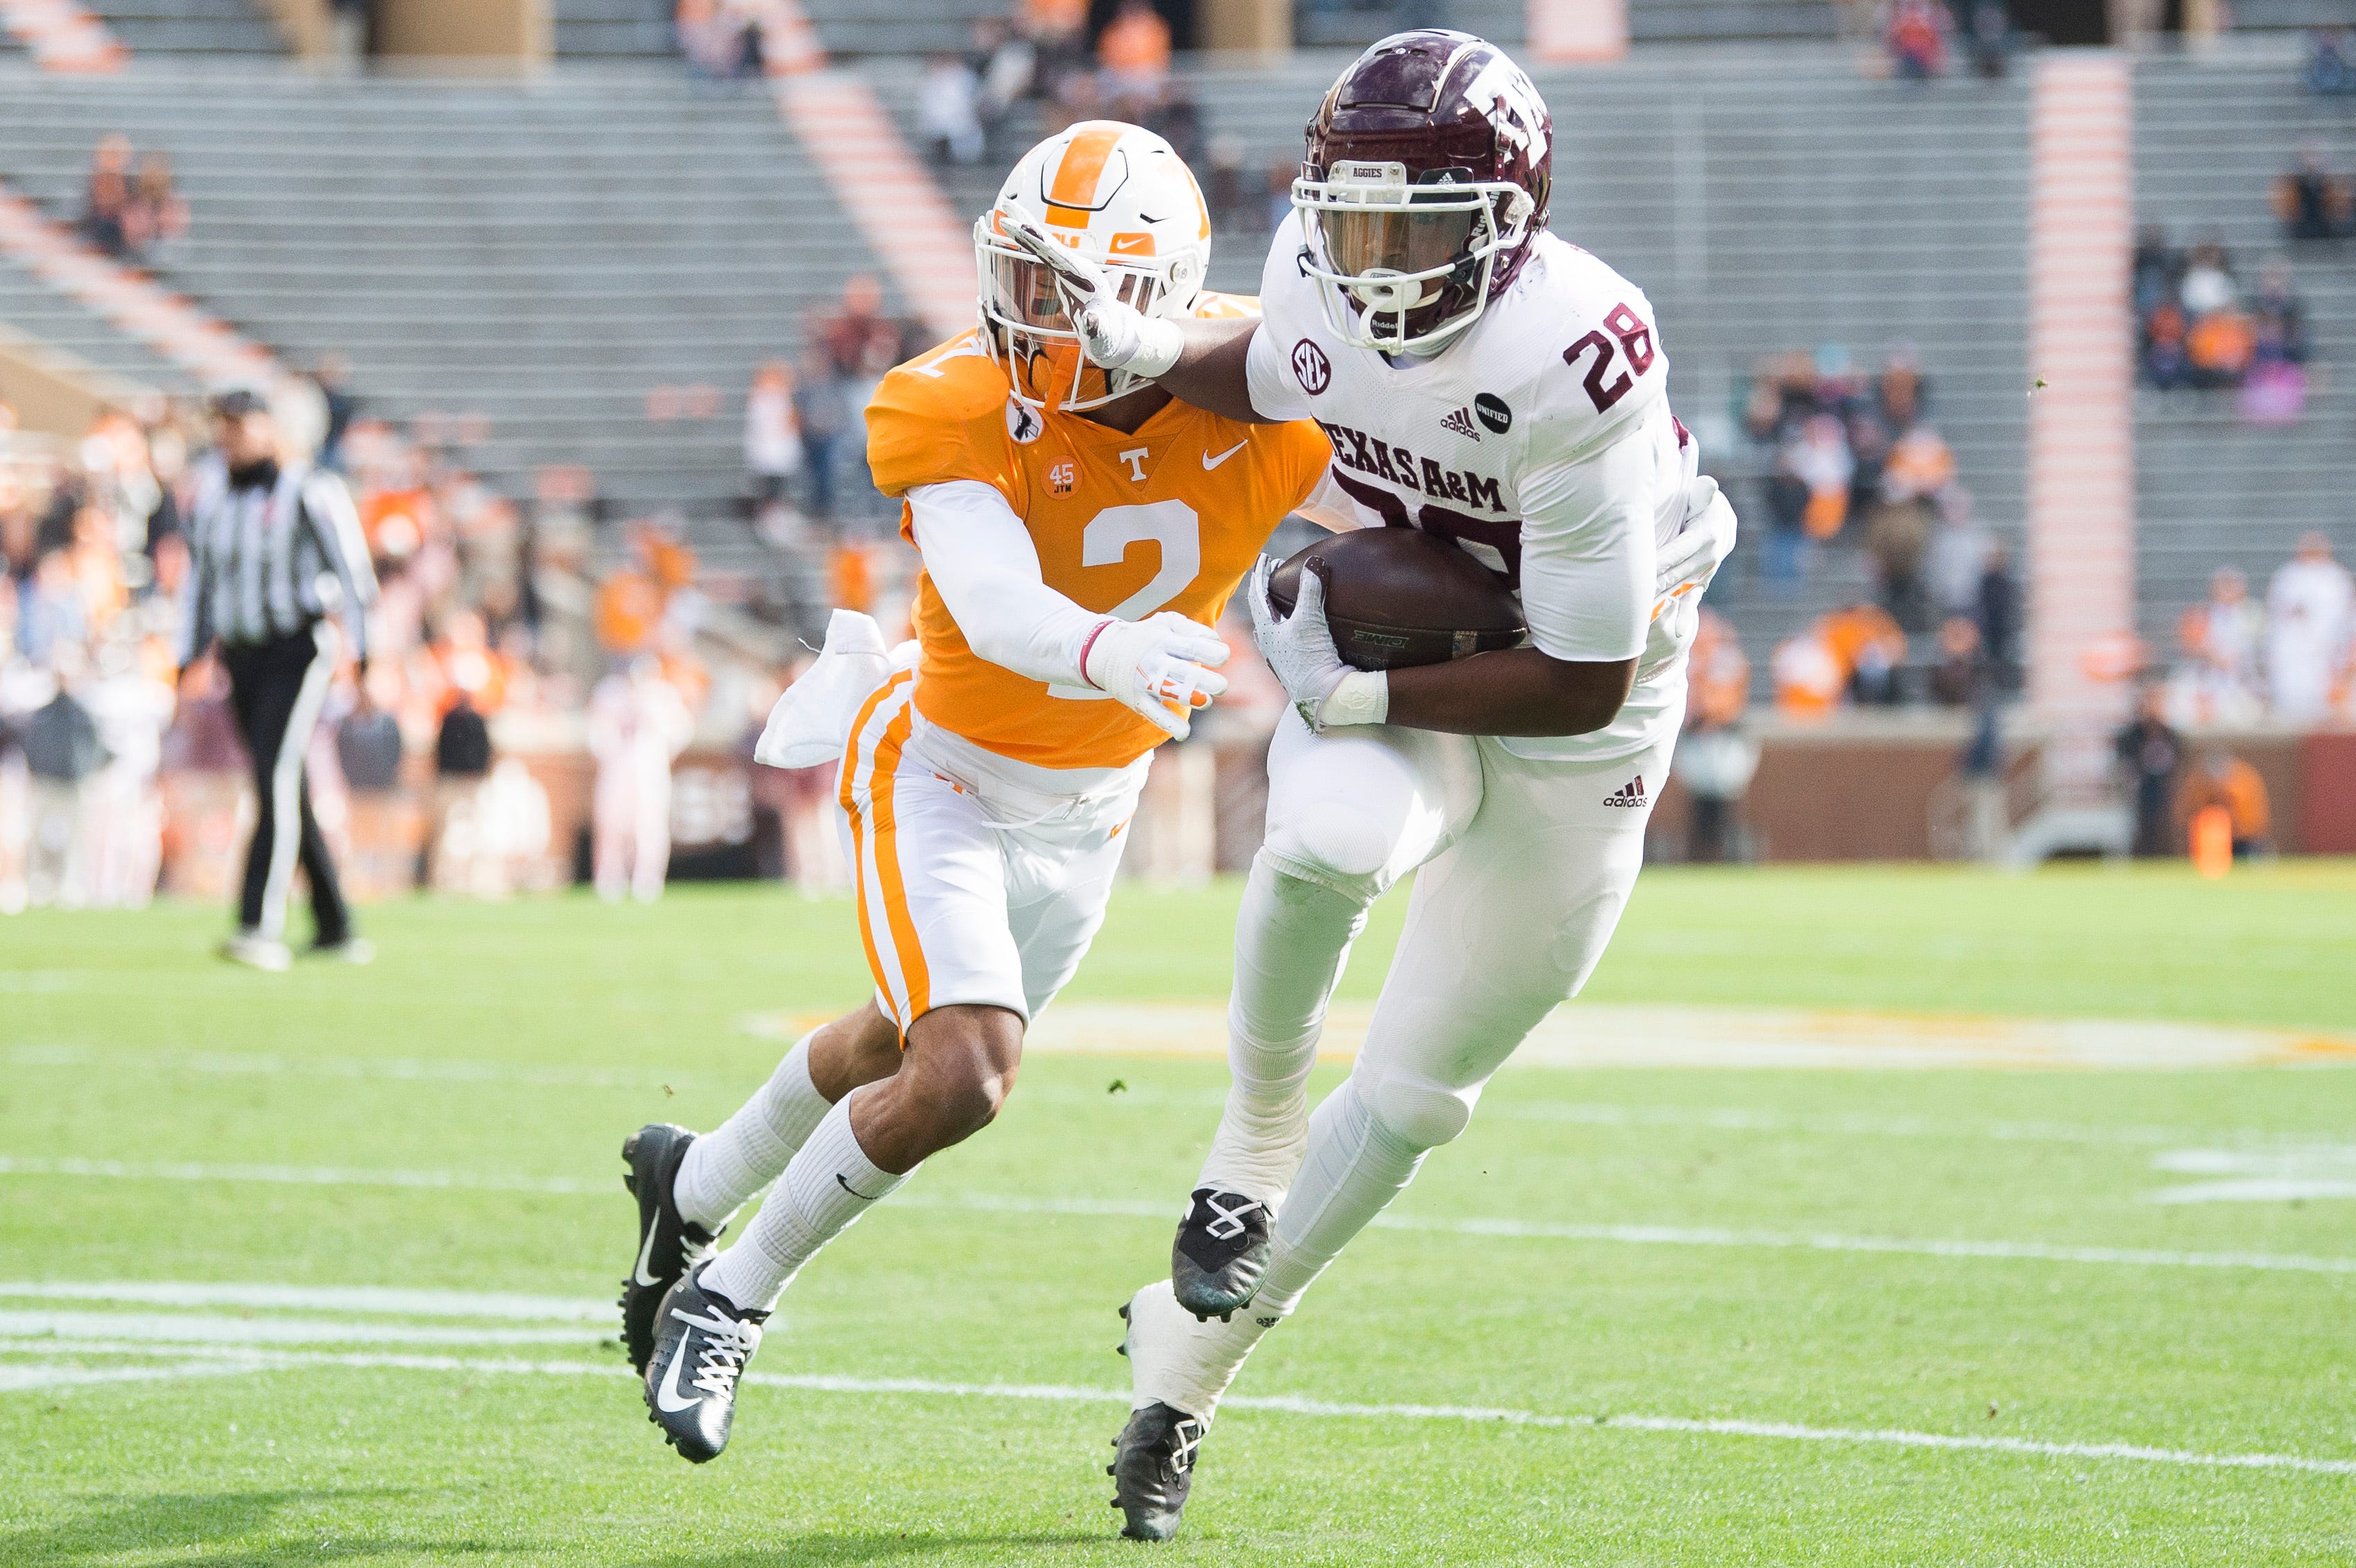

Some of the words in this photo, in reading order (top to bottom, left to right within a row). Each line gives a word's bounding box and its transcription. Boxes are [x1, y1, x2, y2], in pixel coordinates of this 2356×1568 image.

[1353, 167, 1383, 177] AGGIES
[1471, 191, 1501, 238] Ridell
[1371, 319, 1398, 329] Riddel
[1294, 342, 1327, 391] SEC
[1563, 302, 1654, 415] 28
[1476, 402, 1509, 424] UNIFIED
[1440, 419, 1481, 442] adidas
[1049, 463, 1074, 485] 45
[1119, 447, 1149, 482] T
[1054, 485, 1072, 493] JTM
[1421, 456, 1507, 512] A&M
[1048, 498, 1200, 700] 2
[1603, 795, 1648, 808] adidas
